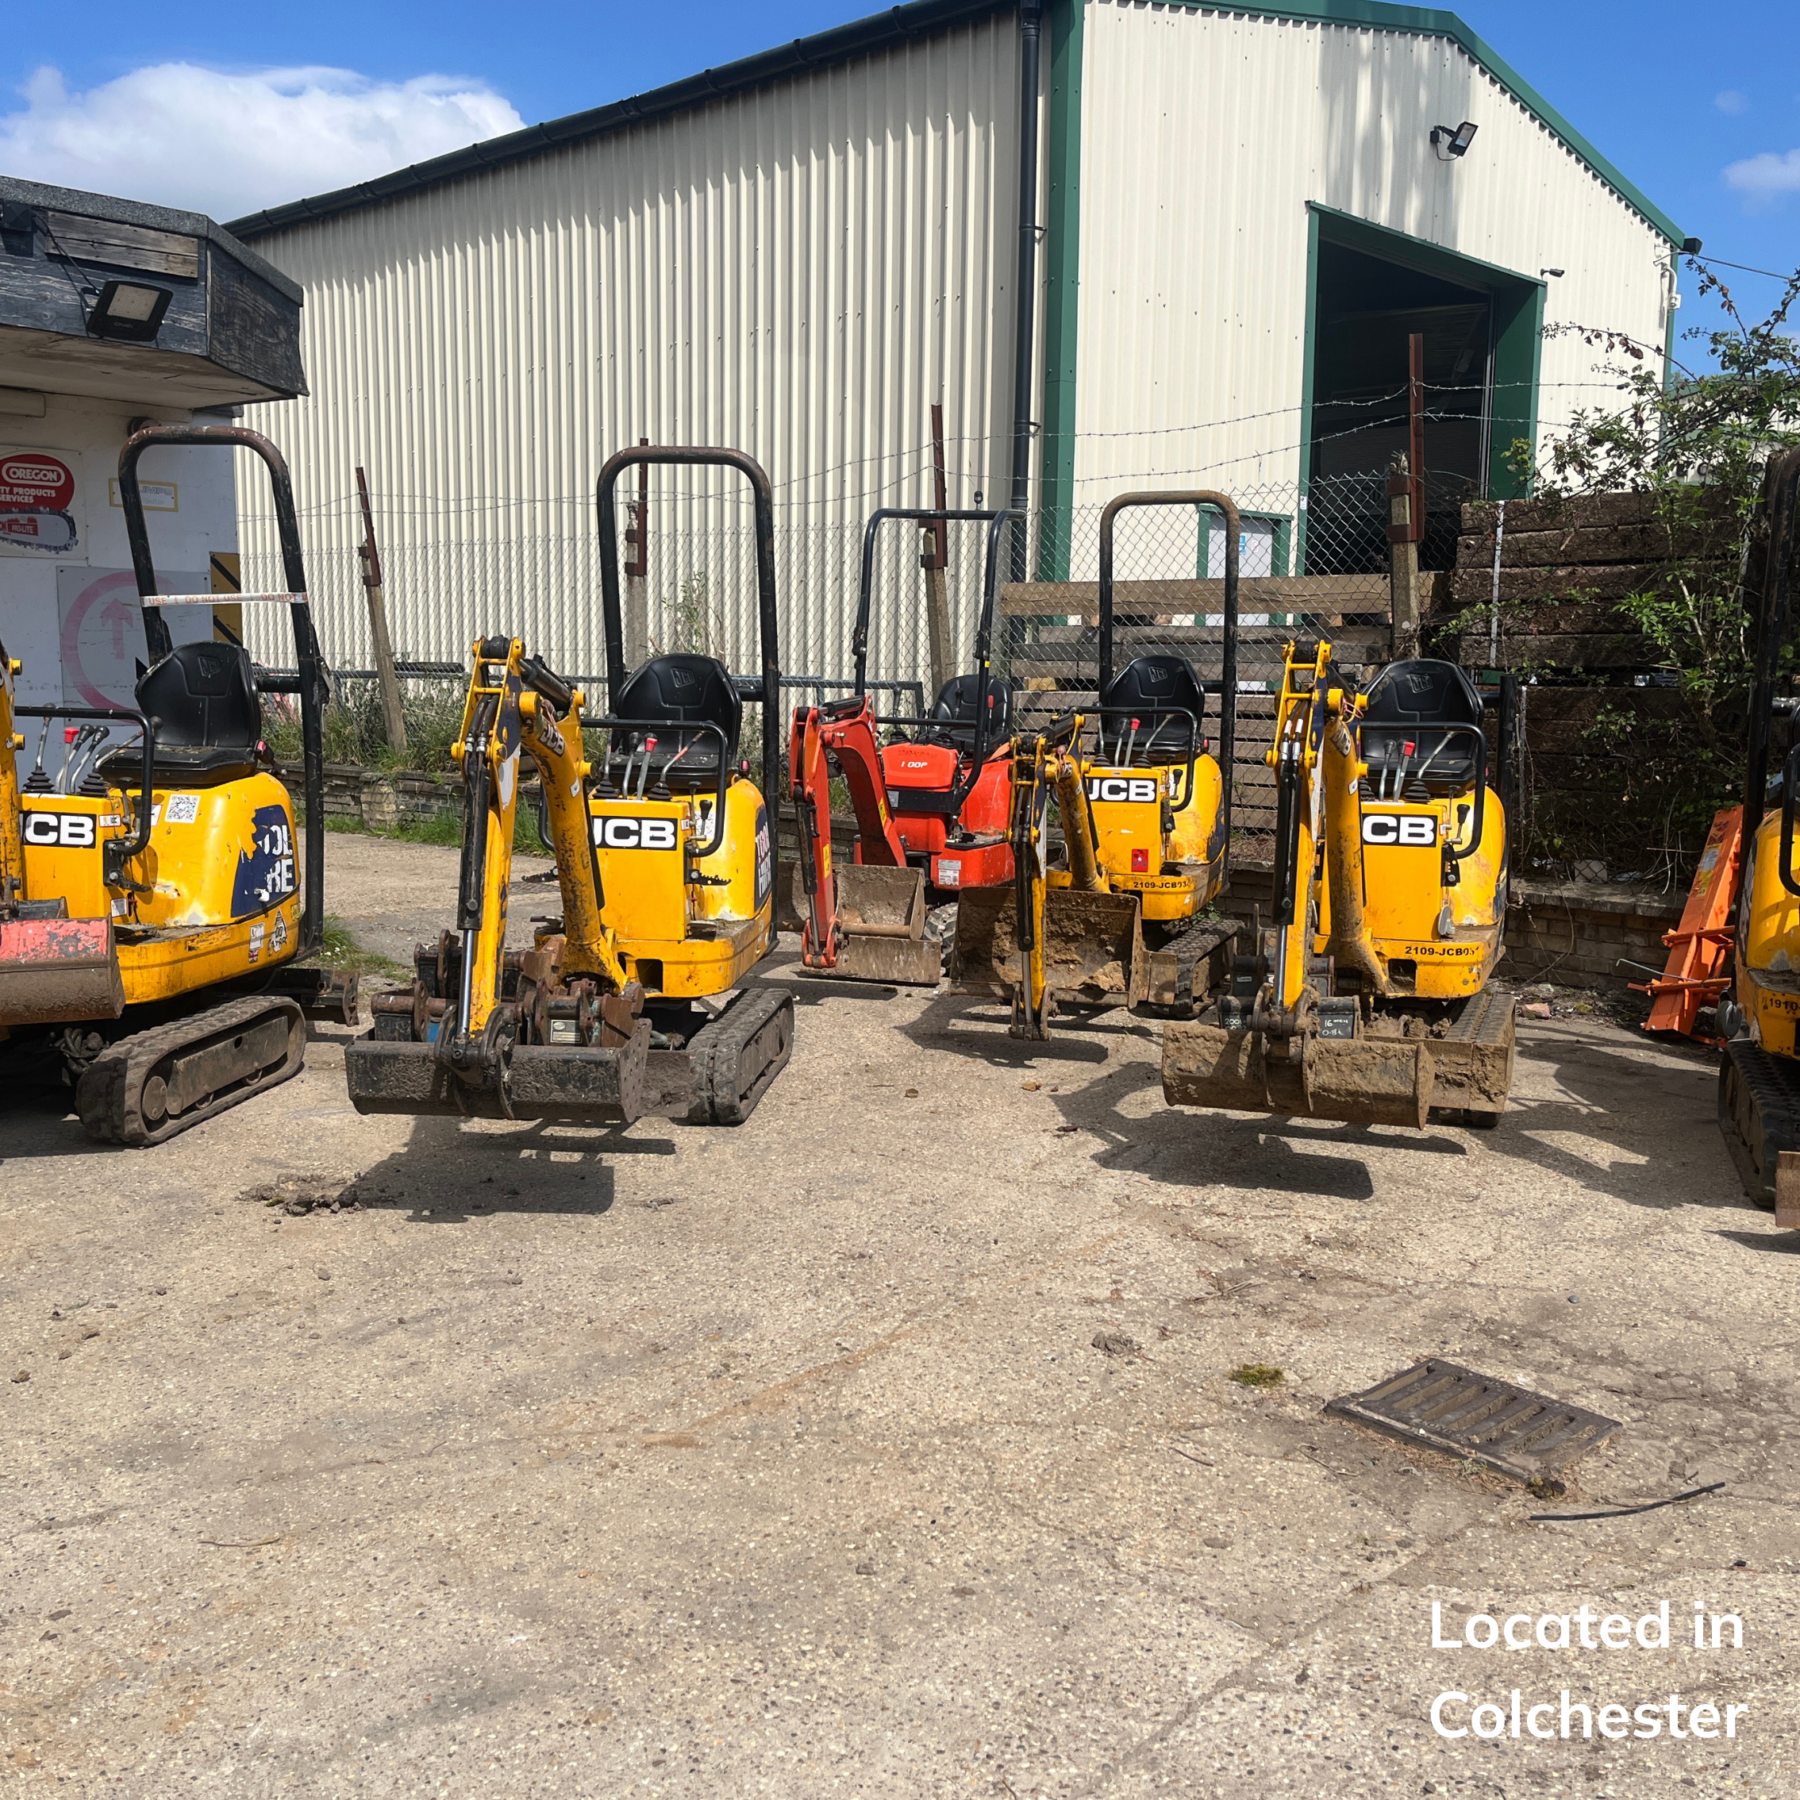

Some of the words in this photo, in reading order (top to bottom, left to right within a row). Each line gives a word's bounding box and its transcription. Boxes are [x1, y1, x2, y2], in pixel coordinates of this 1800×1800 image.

[9, 467, 58, 482] OREGON
[13, 487, 56, 498] PRODUCTS
[149, 597, 167, 606] USE
[185, 596, 199, 604] DO
[202, 595, 220, 603] NOT
[539, 726, 564, 756] JCB
[1088, 779, 1155, 801] JCB
[1362, 816, 1434, 844] CB
